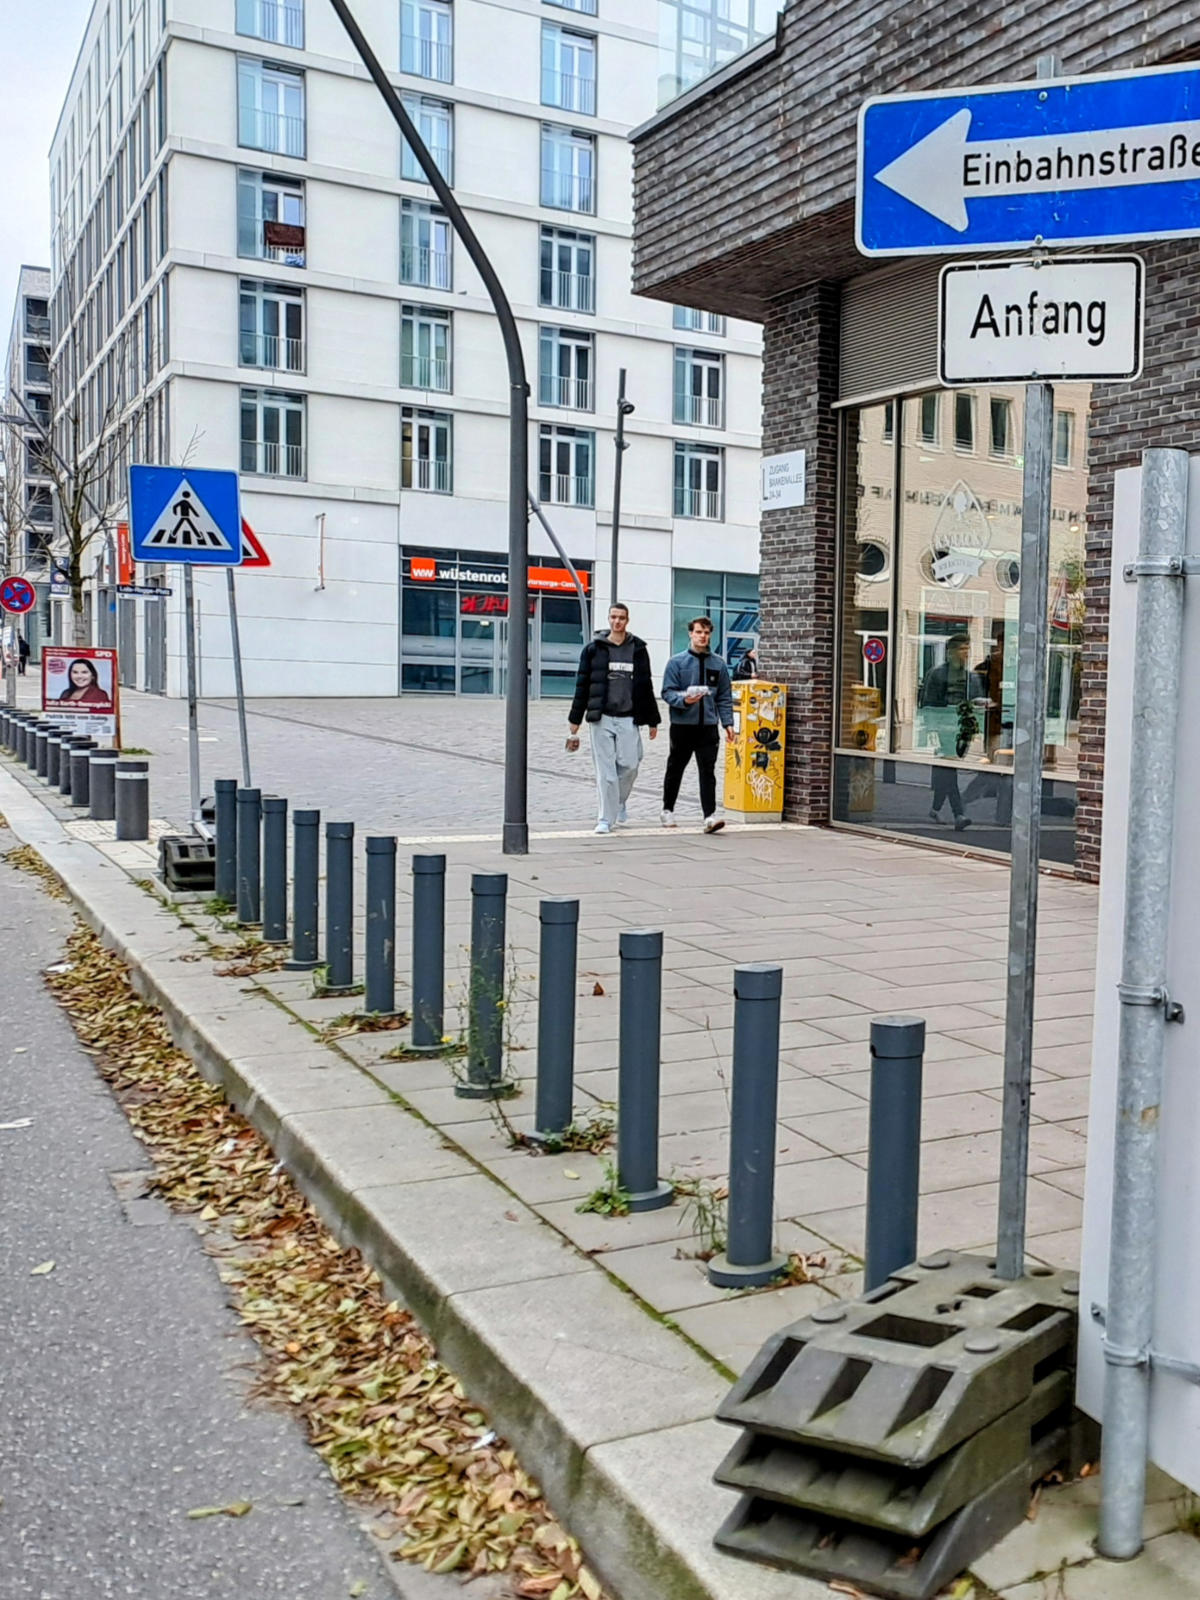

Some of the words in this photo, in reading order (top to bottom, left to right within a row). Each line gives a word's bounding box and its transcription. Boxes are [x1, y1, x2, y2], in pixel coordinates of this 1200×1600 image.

[969, 291, 1106, 346] Anfang
[439, 567, 508, 583] wüstenrot
[94, 650, 112, 658] SPD
